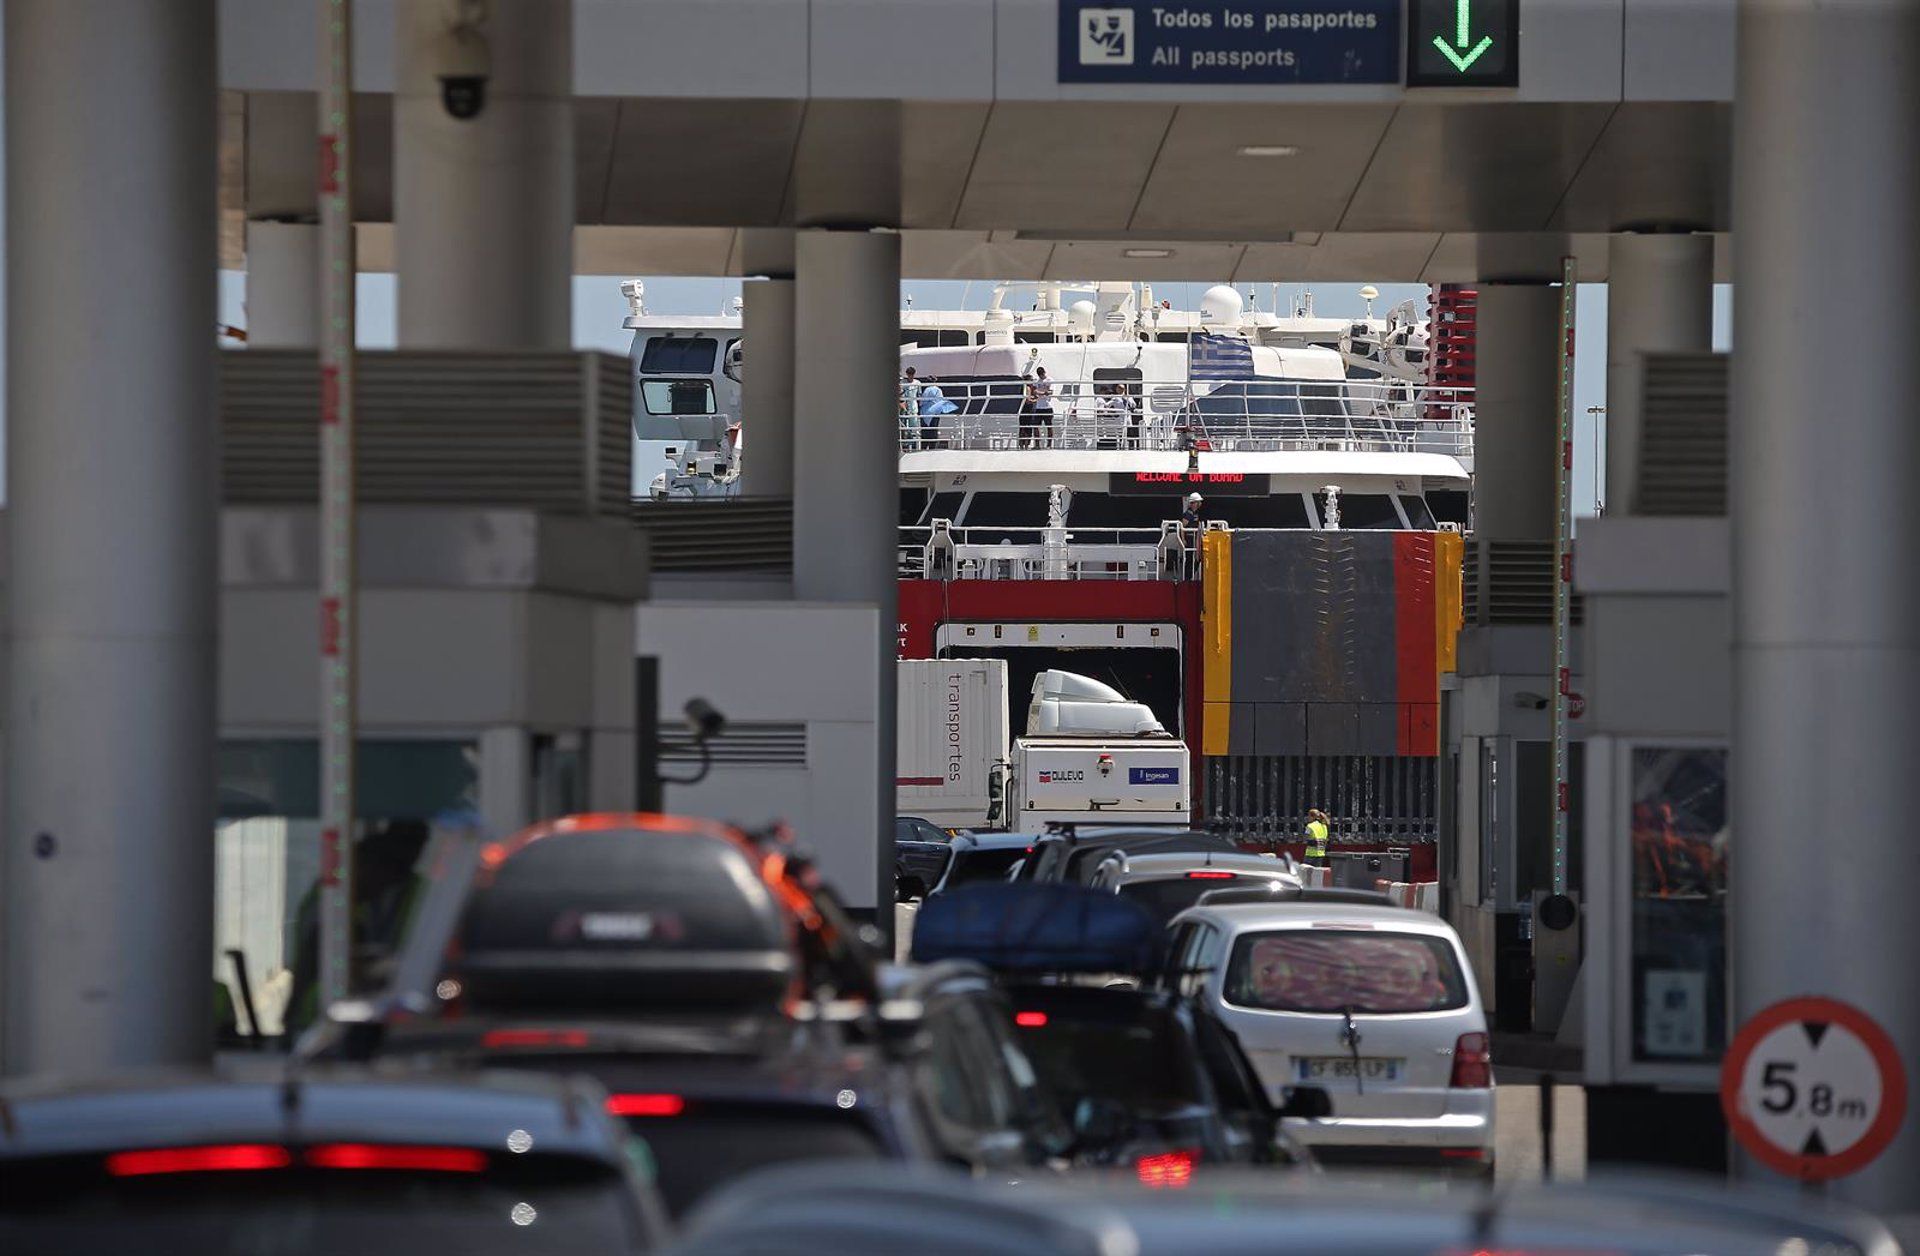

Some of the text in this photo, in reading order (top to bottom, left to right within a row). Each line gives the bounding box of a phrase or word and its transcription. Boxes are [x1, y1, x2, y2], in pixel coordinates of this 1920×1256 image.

[1152, 9, 1378, 32] Todos los pasaportes
[1152, 47, 1296, 70] All passports
[946, 673, 962, 782] transportes
